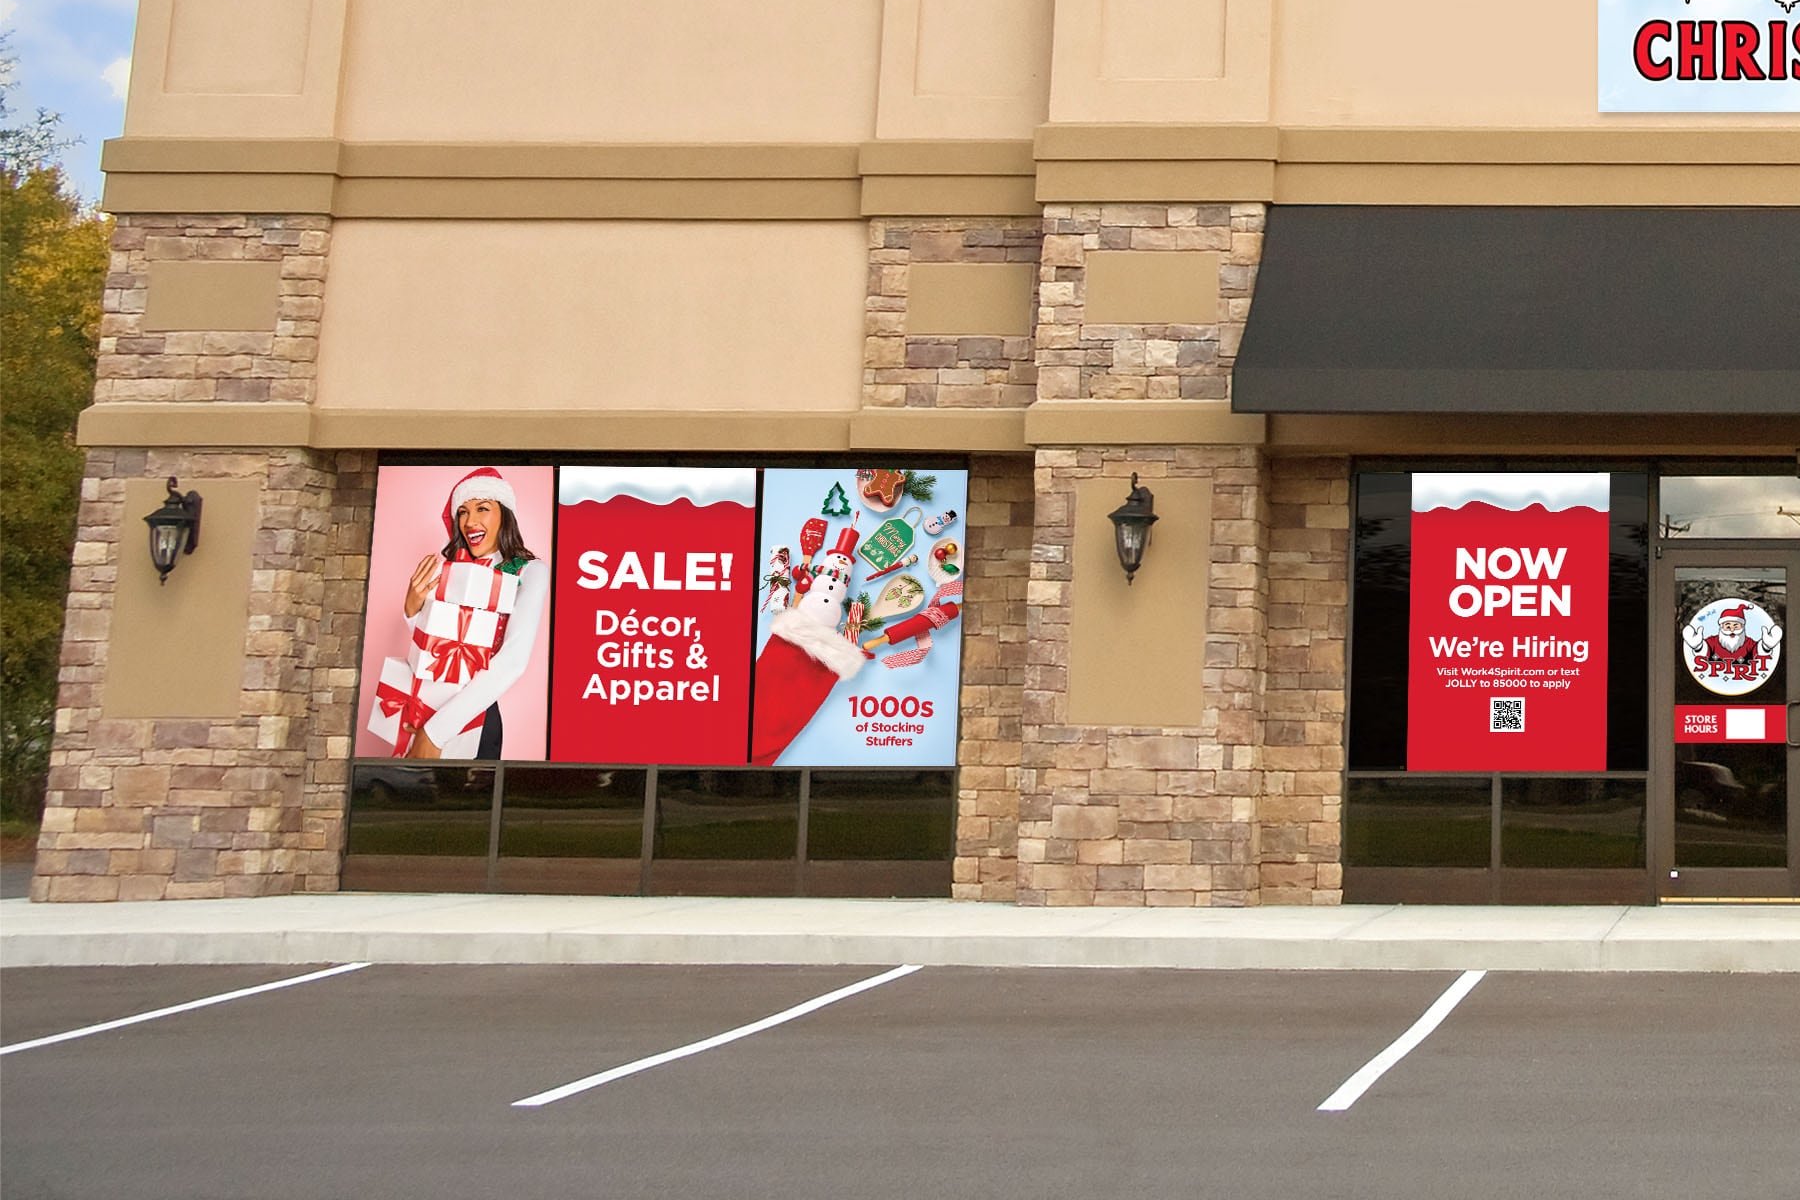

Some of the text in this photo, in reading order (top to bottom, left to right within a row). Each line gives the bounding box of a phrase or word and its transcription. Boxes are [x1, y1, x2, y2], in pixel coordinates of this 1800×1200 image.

[576, 550, 734, 591] SALE!
[1455, 546, 1568, 580] NOW
[1448, 584, 1572, 618] OPEN
[595, 608, 702, 643] Décor,
[596, 641, 709, 670] Gifts &
[1512, 635, 1589, 663] Hiring
[1436, 666, 1459, 676] Visit
[1460, 666, 1545, 678] Work4Spirit.com
[1560, 667, 1580, 676] text
[1693, 654, 1773, 682] SPIRIT
[581, 673, 720, 706] Apparel
[1445, 678, 1571, 690] JOLLY to 85000 to apply
[848, 695, 934, 718] 1000s
[1684, 714, 1718, 725] STORE
[855, 721, 925, 735] of Stocking
[865, 735, 914, 747] Stuffers
[1683, 724, 1718, 734] HOURS
